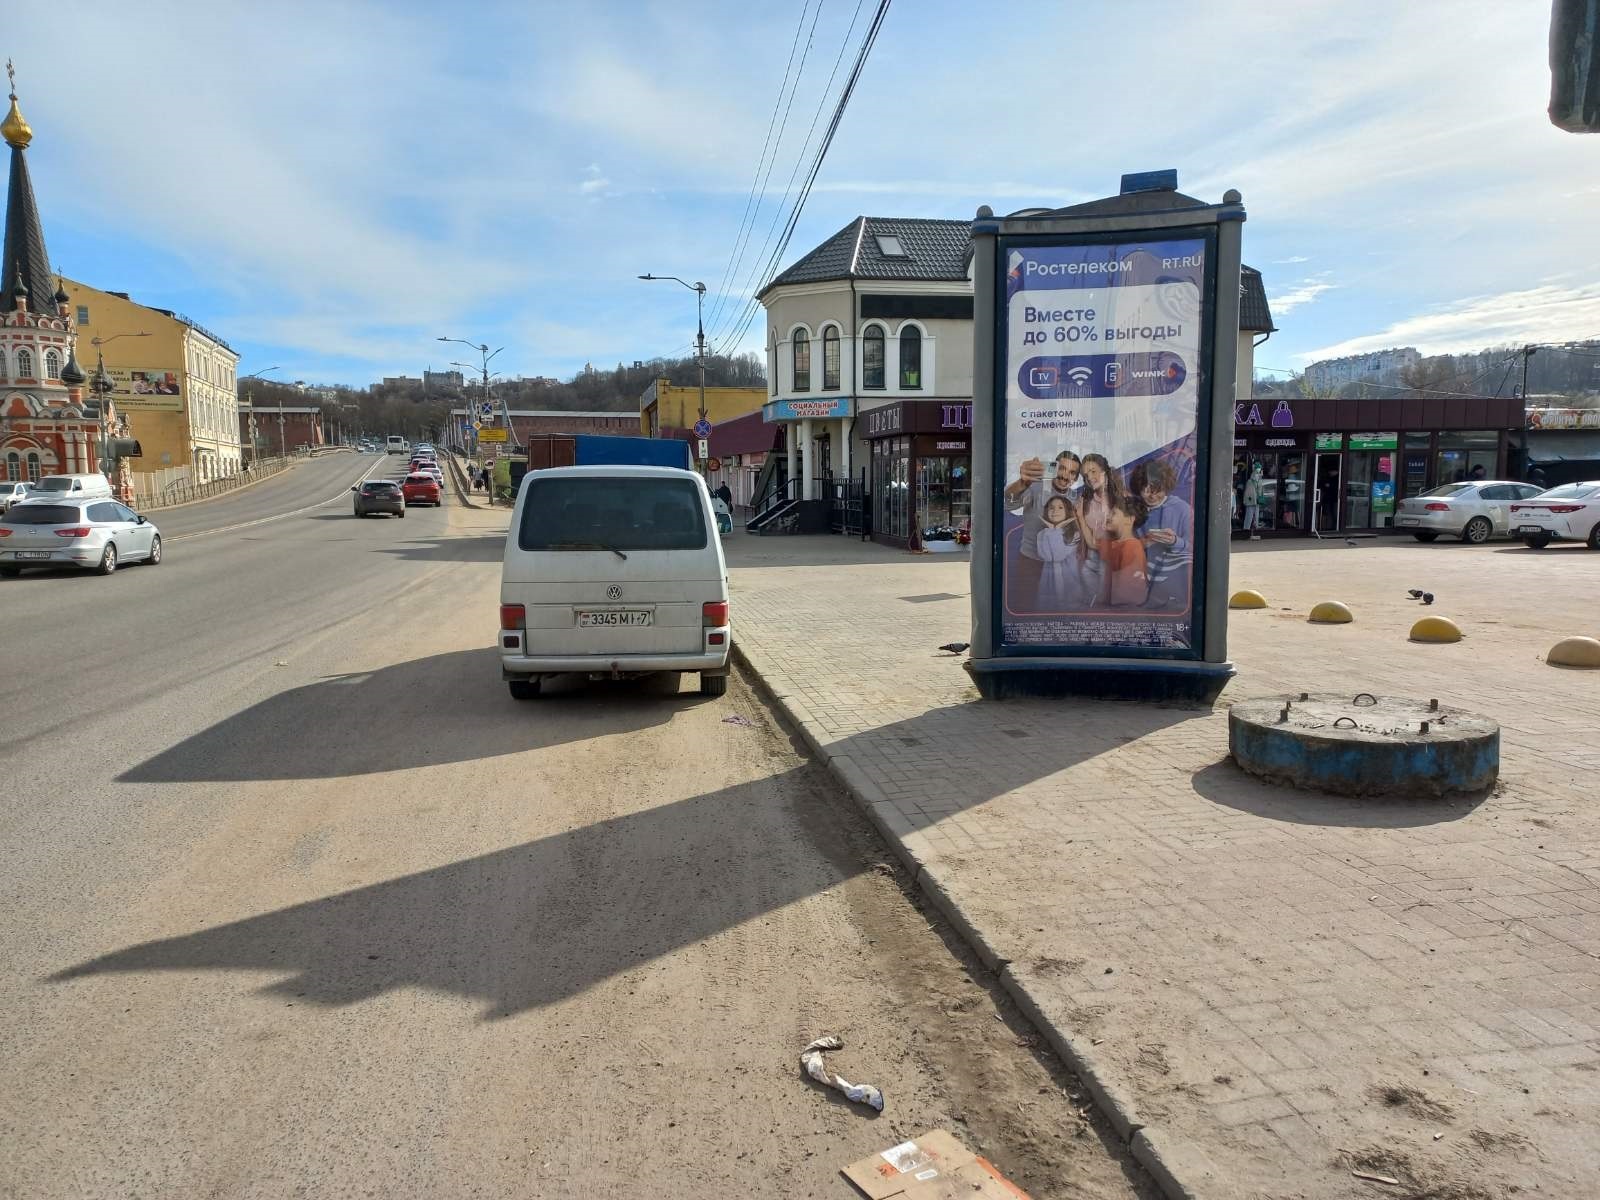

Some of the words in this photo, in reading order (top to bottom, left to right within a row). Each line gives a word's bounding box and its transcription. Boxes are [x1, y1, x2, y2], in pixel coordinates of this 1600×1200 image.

[1025, 260, 1133, 276] Ростелеком
[1162, 255, 1202, 269] RT.RU
[1023, 306, 1096, 323] Вместе
[1023, 329, 1047, 346] до
[1053, 326, 1098, 343] 60%
[1105, 324, 1182, 342] выгоды
[788, 400, 838, 410] СОЦИАЛЬНЫЙ
[796, 409, 831, 417] МАГАЗИН
[1030, 409, 1073, 418] пакетом
[869, 407, 900, 434] ЦВЕТЫ
[591, 613, 617, 625] 3345
[1175, 624, 1190, 632] 18+
